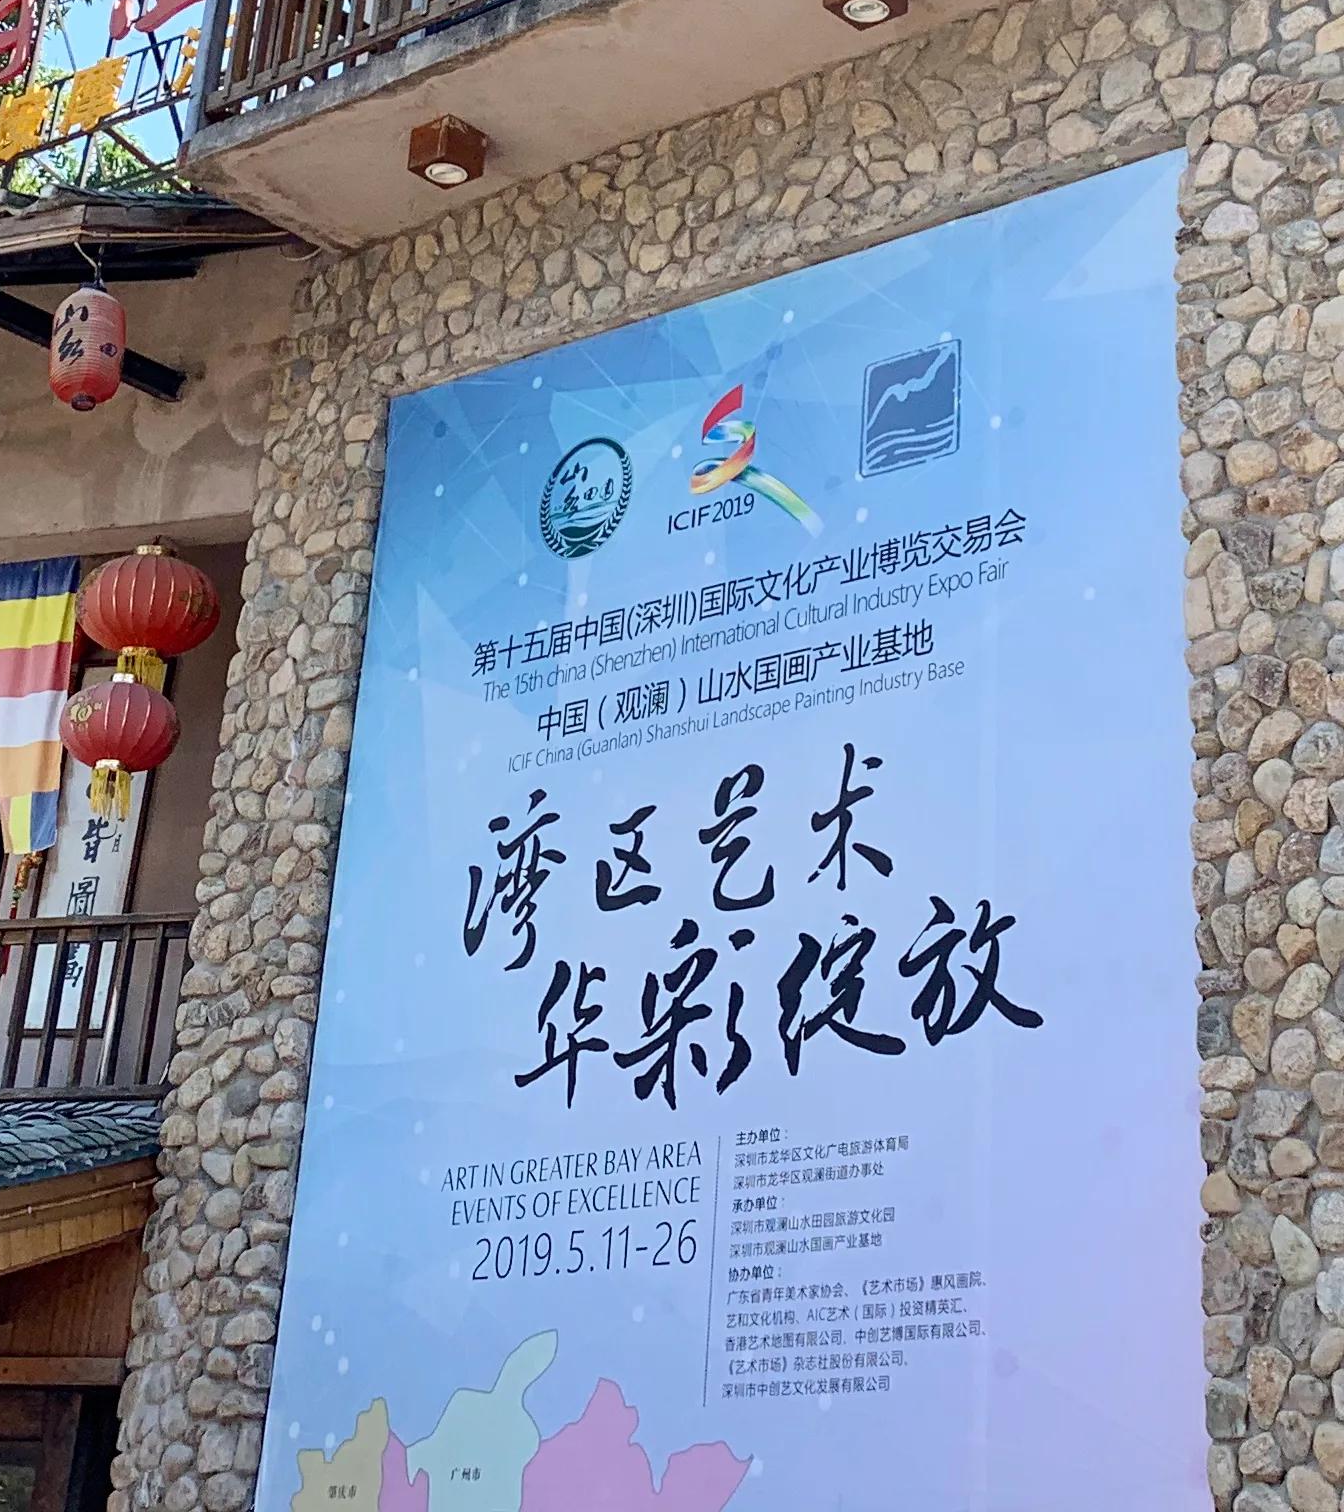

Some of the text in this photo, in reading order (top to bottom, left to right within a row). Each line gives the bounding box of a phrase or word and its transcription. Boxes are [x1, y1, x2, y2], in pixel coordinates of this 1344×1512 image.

[472, 508, 1027, 677] 第十五届中国(深圳)国际文化产业博览交易会
[483, 559, 1009, 703] The 15th china (Shenzhen) International Cultural Industry Expo Fair
[508, 660, 965, 773] ICIF China (Guanlan) Shanshui Landscape Painting Industry Base
[463, 743, 894, 971] 湾区艺术
[514, 896, 1044, 1110] 华彩绽放
[441, 1140, 702, 1192] ART IN GREATER BAY AREA
[733, 1161, 885, 1190] 深圳市龙华区观澜街道办事处
[734, 1135, 909, 1169] 深圳市龙华区文化广电旅游体育局
[451, 1176, 701, 1226] EVENTS OF EXCELLENCE
[730, 1207, 895, 1236] 深圳市观澜山水田园旅游文化园
[472, 1218, 697, 1281] 2019.5.11-26
[729, 1231, 882, 1259] 深圳市观澜山水国画产业基地
[449, 1466, 482, 1483] 广州市
